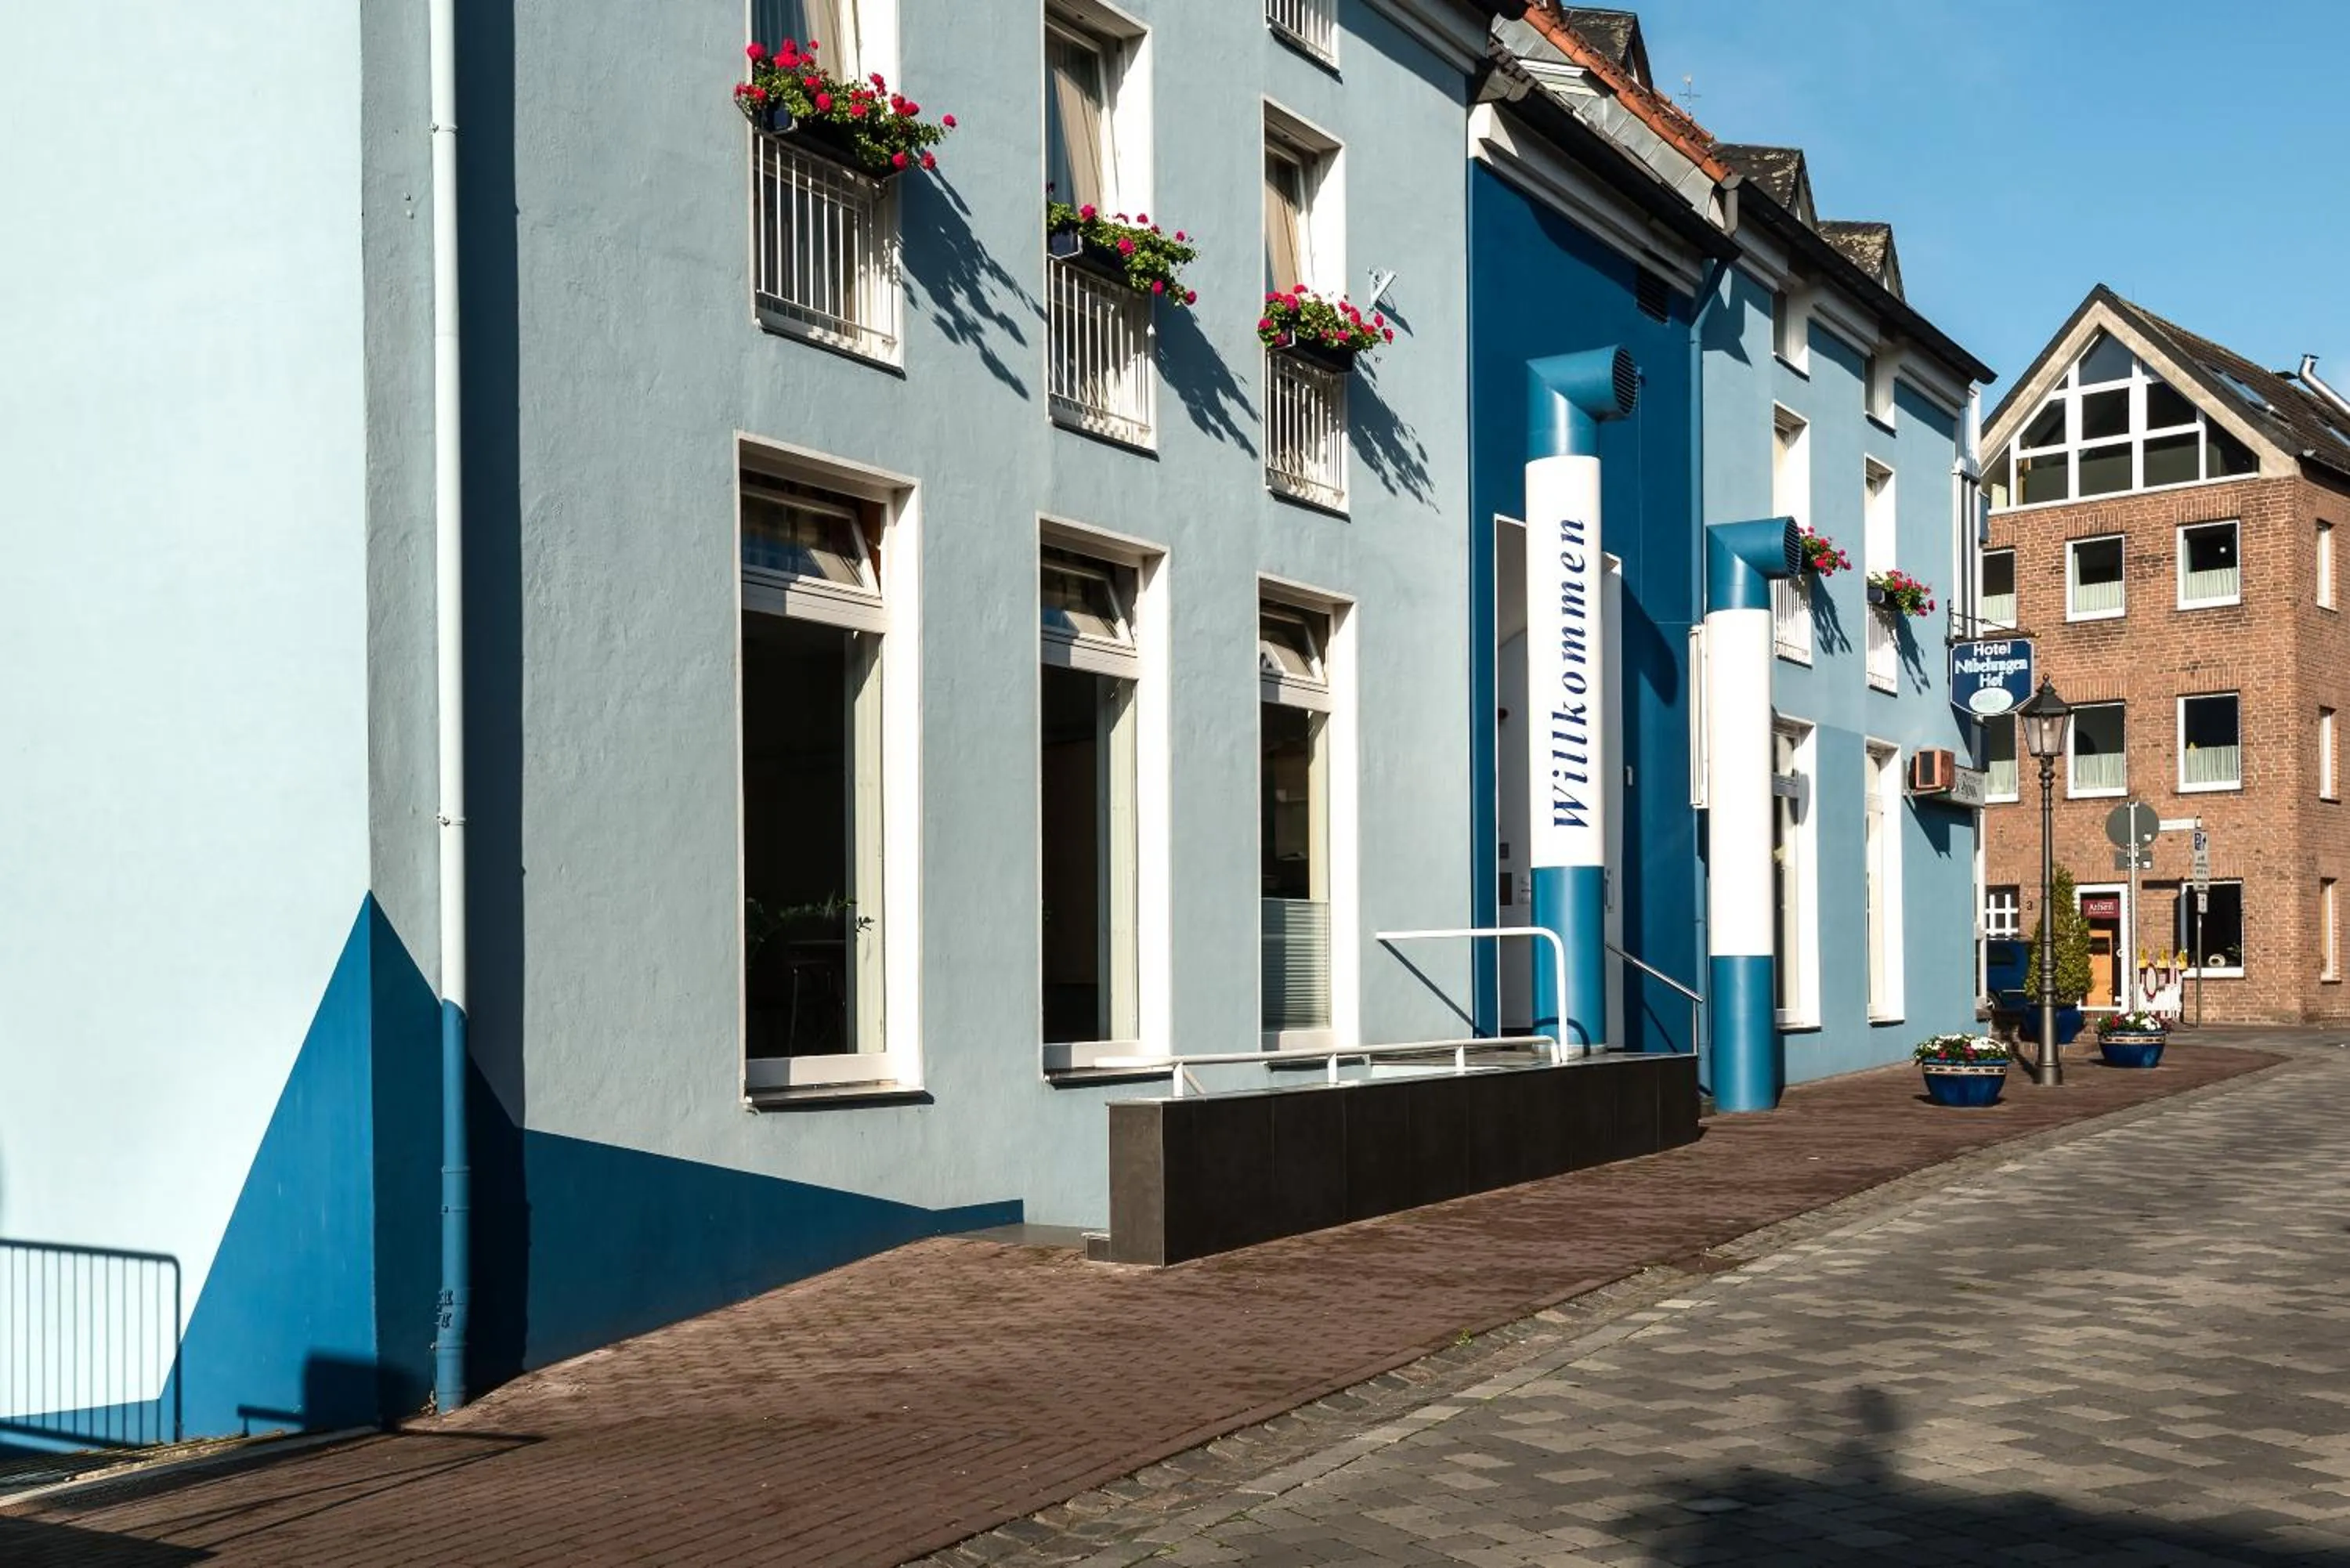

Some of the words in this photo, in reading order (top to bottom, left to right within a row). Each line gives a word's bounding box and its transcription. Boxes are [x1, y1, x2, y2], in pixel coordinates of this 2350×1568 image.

[1973, 641, 2011, 656] Hotel
[1552, 518, 1589, 828] Willkommen
[1979, 673, 2005, 688] Hof
